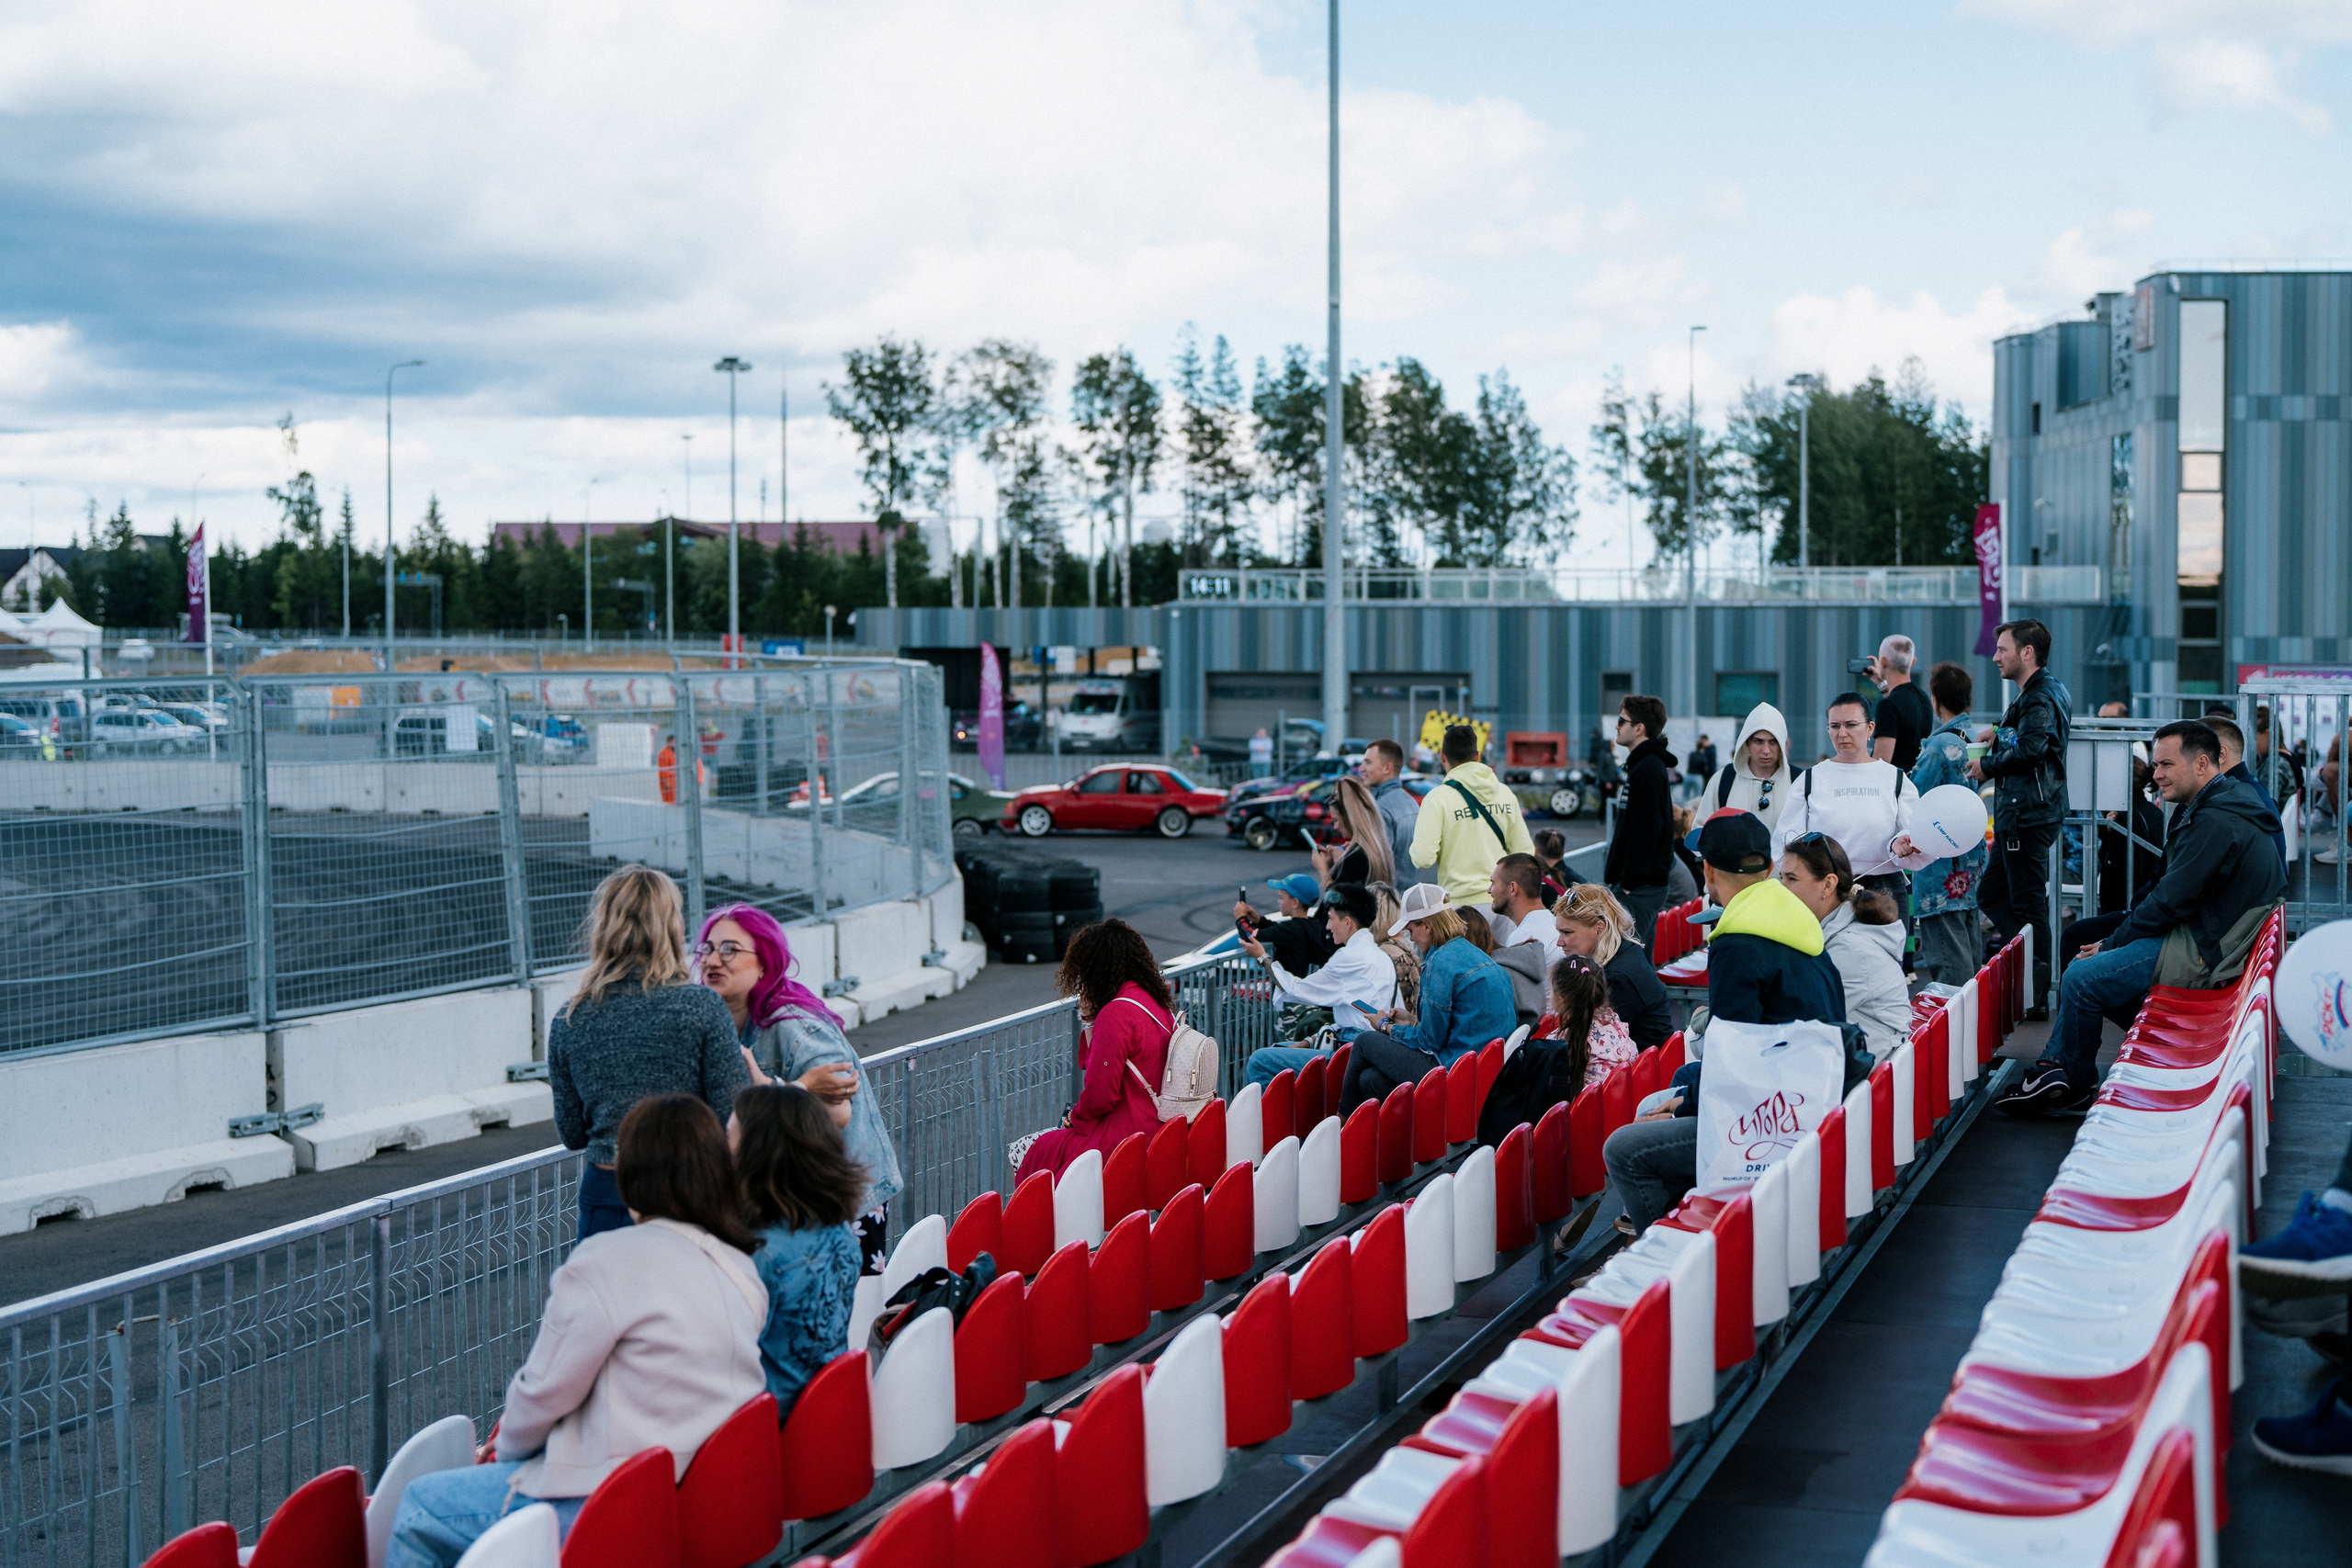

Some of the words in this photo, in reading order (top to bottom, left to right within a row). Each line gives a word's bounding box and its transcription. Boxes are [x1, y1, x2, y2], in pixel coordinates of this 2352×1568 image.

[1190, 577, 1230, 594] 14:11
[1834, 787, 1880, 797] INSPIRATION
[1453, 803, 1512, 820] RETIVE
